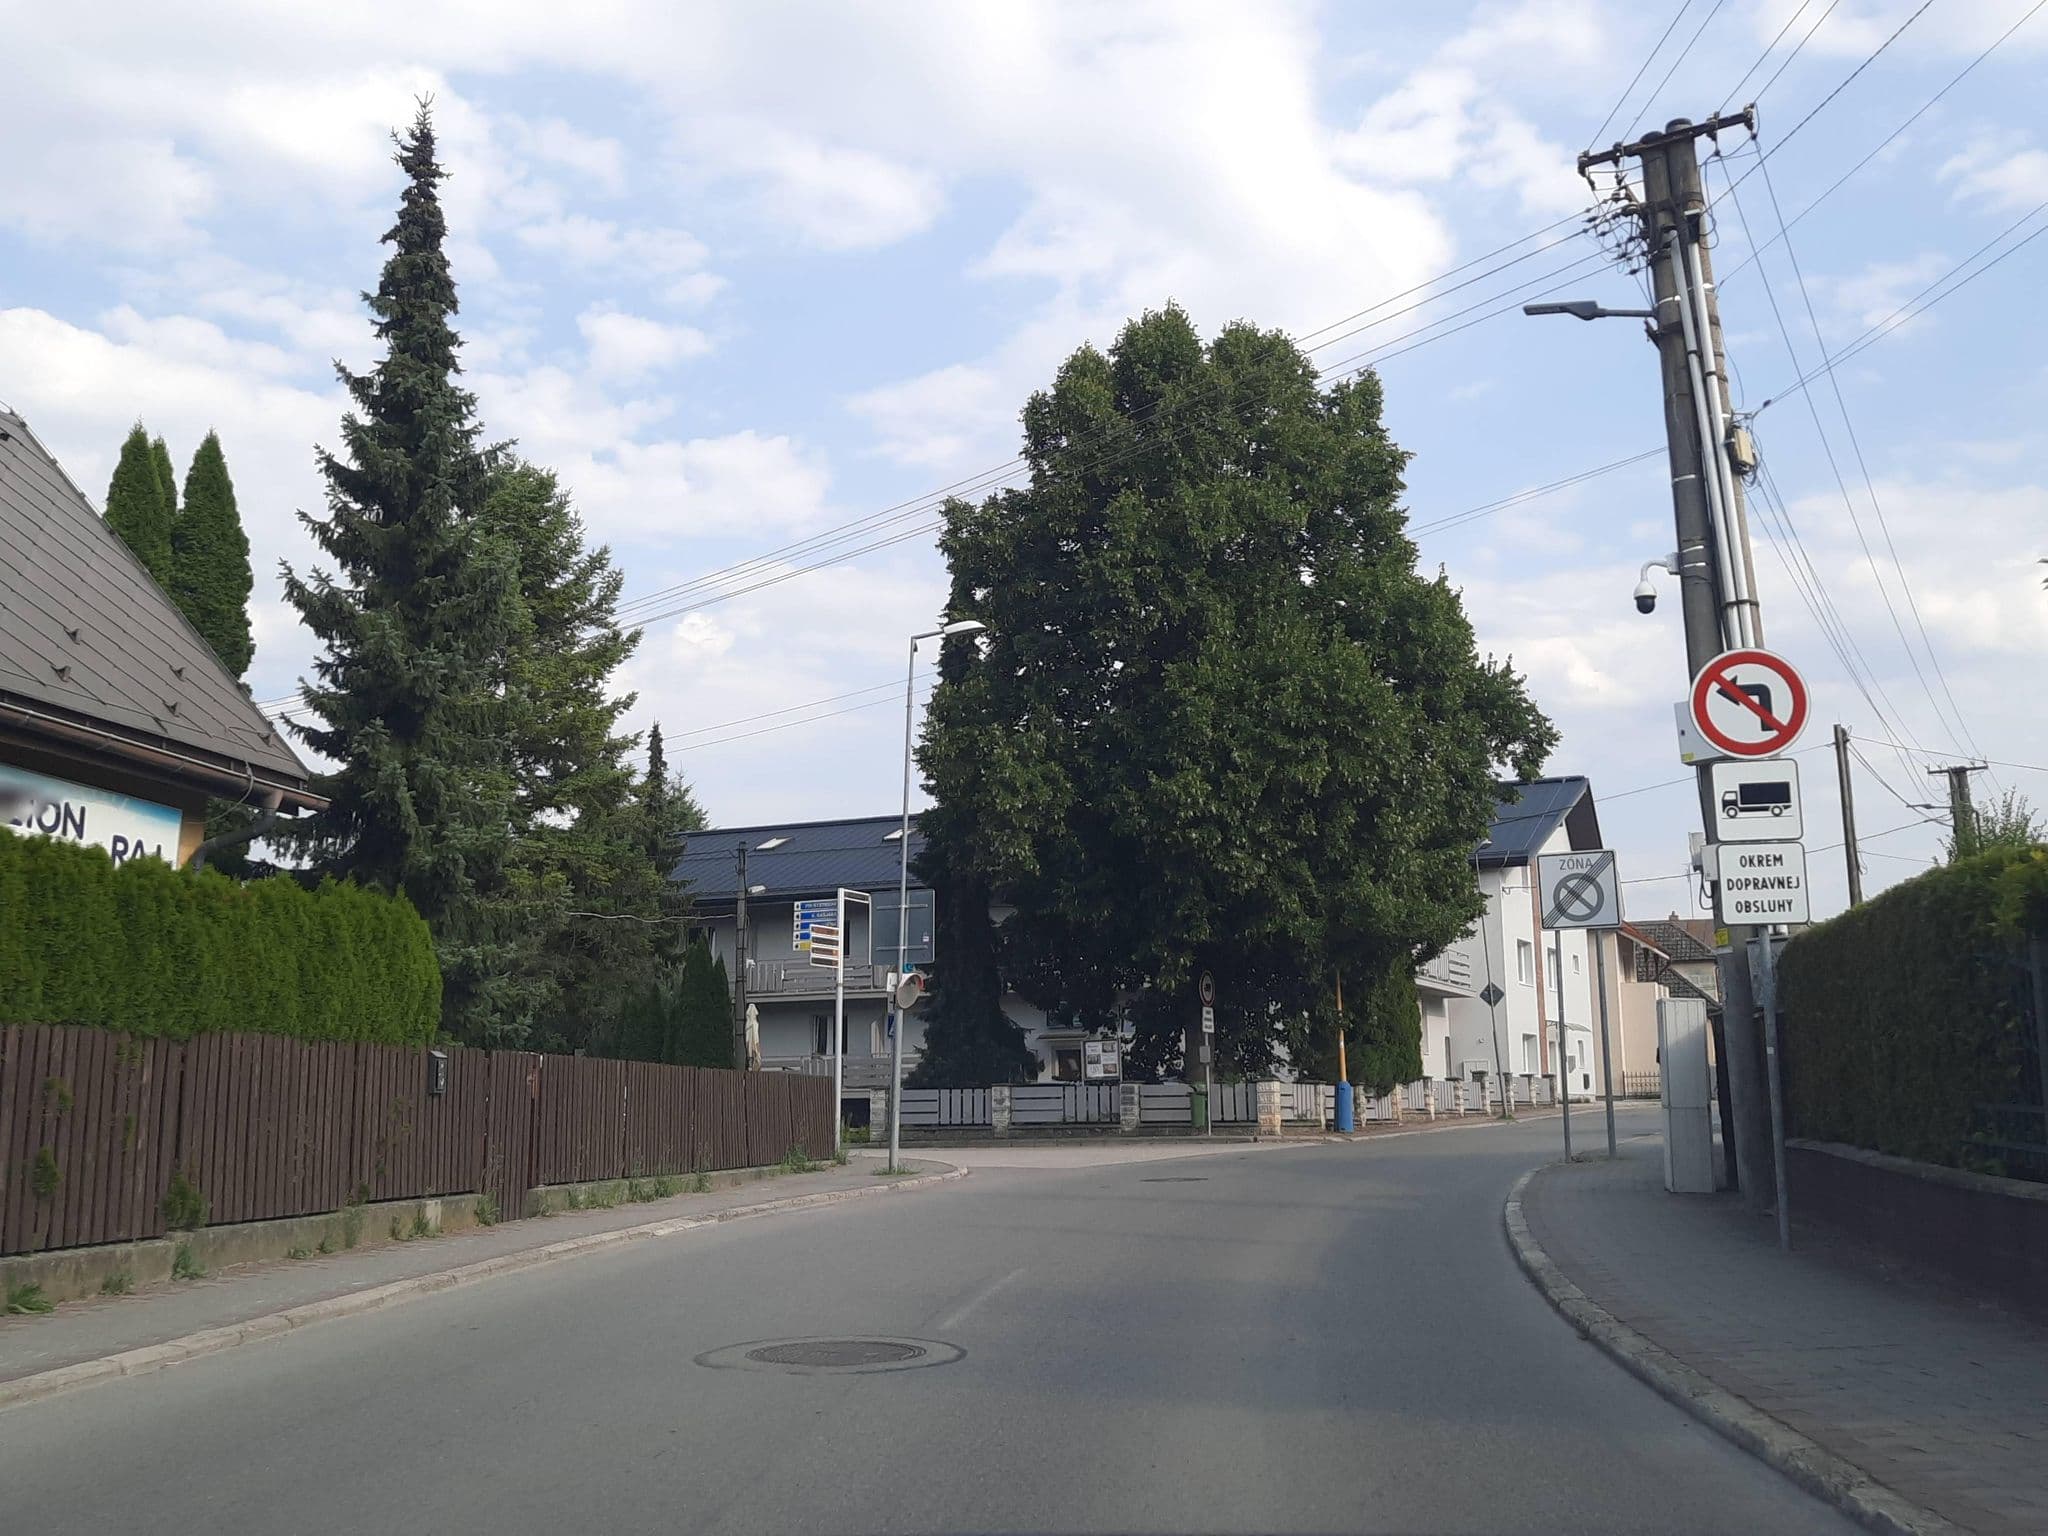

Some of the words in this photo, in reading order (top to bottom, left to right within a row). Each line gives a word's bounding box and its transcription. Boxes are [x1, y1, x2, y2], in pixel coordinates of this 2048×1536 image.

[1739, 854, 1784, 868] OKREM
[1727, 876, 1801, 891] DOPRAVNEJ
[1735, 899, 1794, 913] OBSLUHY
